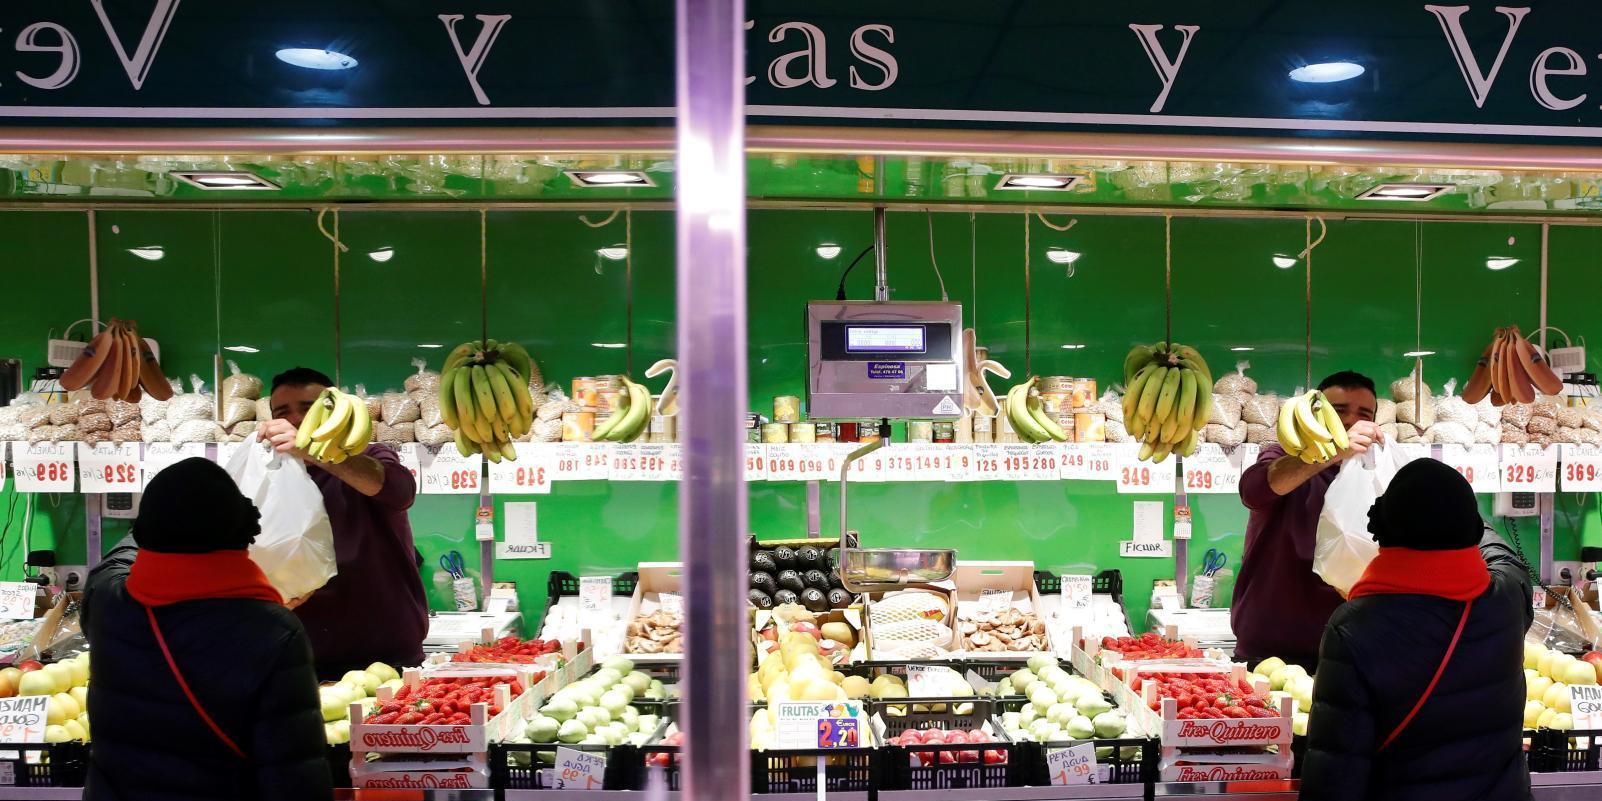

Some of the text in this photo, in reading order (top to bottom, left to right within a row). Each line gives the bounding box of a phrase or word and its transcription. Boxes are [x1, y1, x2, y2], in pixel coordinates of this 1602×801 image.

[745, 5, 1602, 112] as y Ve
[888, 457, 912, 471] 375
[976, 460, 998, 472] 125
[1003, 456, 1030, 471] 195
[1032, 457, 1056, 470] 280
[1061, 454, 1084, 466] 249
[1088, 459, 1109, 472] 180
[1571, 686, 1602, 701] MAN
[782, 705, 819, 717] FRUTAS
[1178, 720, 1281, 743] Fres-Quintero
